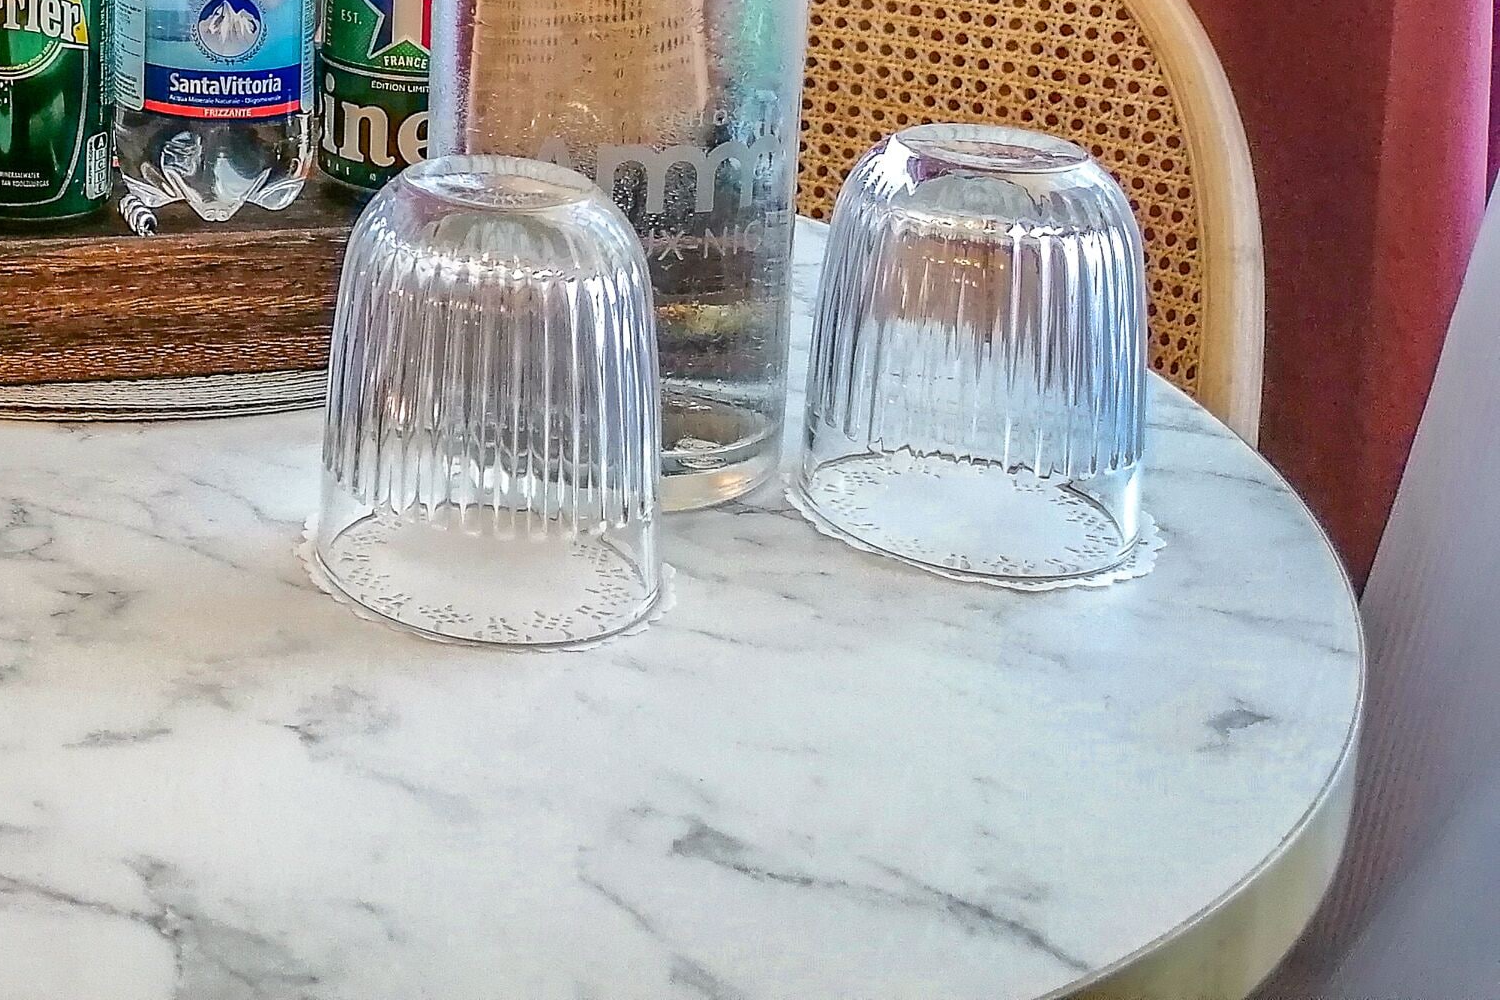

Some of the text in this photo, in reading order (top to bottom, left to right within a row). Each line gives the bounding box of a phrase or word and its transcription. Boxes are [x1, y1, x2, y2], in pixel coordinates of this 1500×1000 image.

[339, 8, 363, 26] EST.
[383, 55, 428, 70] FRANCE
[169, 73, 283, 96] SantaVittoria
[203, 108, 252, 118] FRIZZANTE
